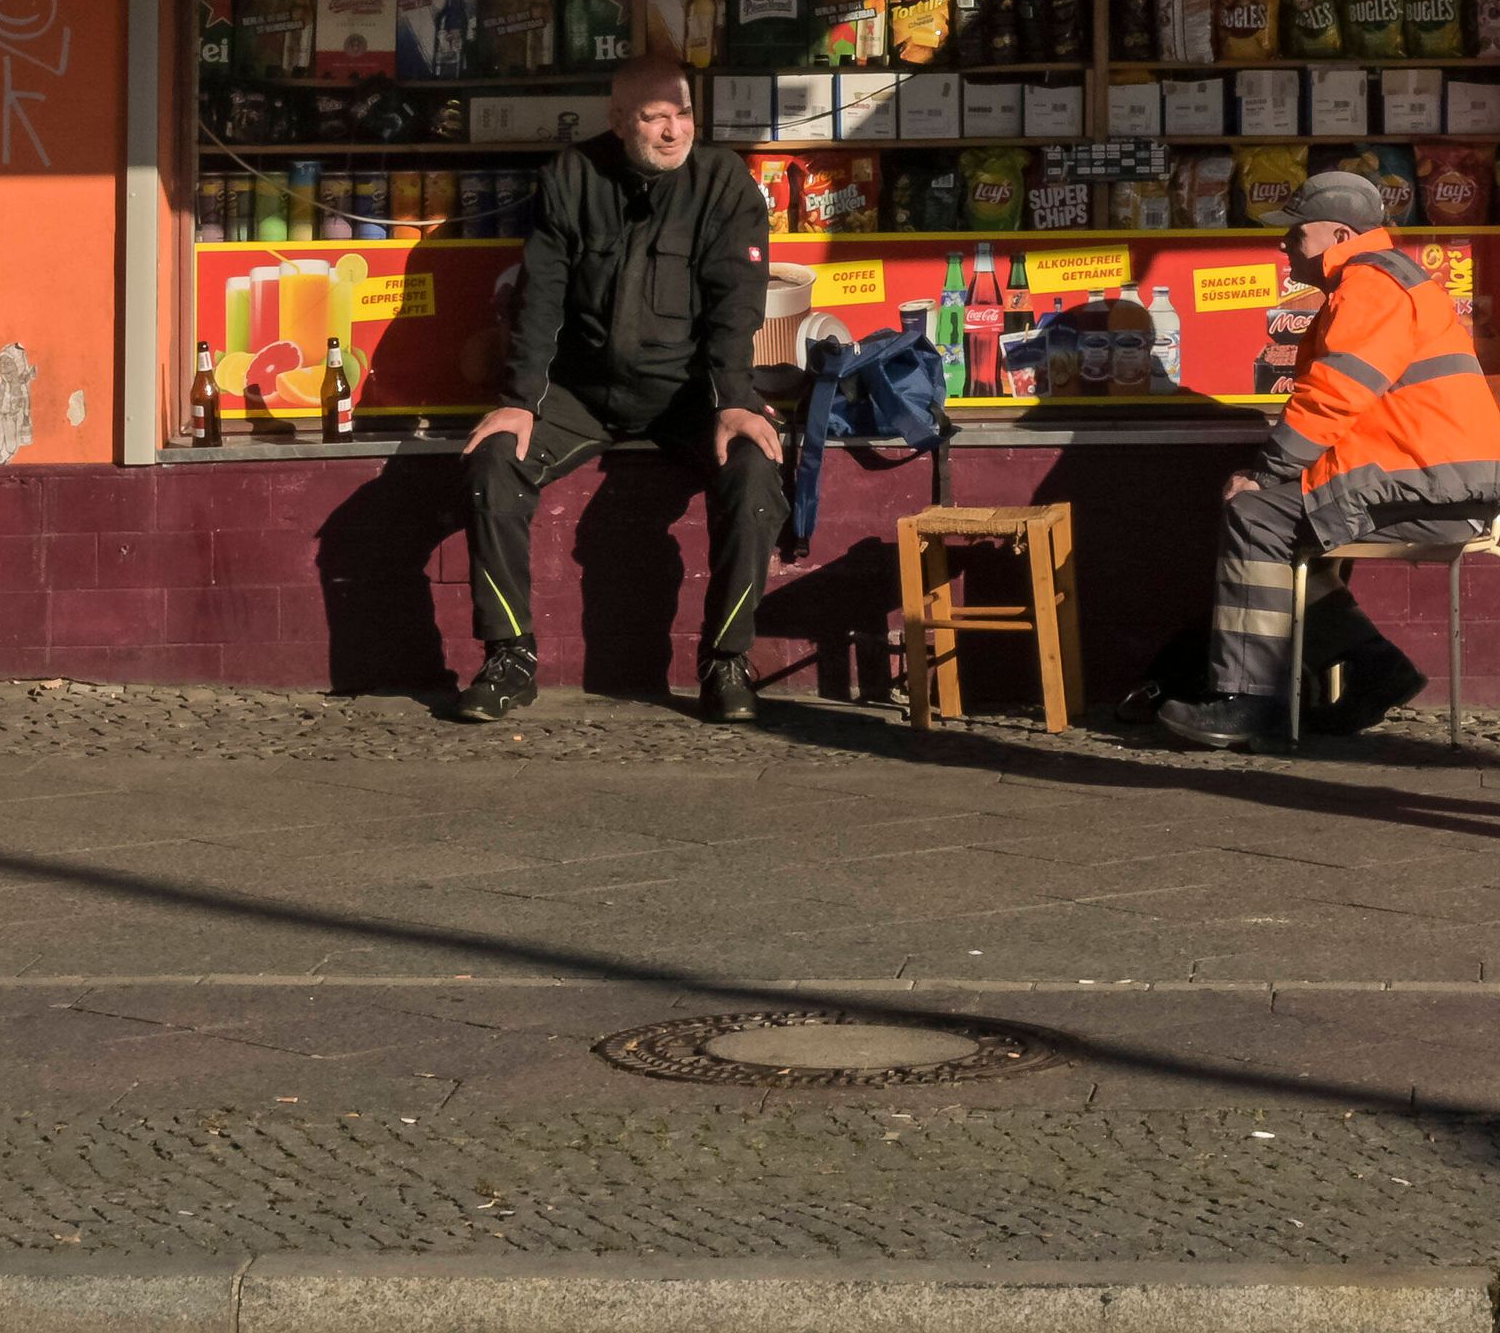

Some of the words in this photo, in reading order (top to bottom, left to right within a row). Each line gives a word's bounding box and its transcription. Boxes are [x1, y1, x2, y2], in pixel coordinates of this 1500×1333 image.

[1029, 184, 1088, 211] SUPER
[1435, 181, 1473, 202] Lay's
[1037, 254, 1123, 271] ALKOHOLFREIE
[833, 269, 876, 282] COFFEE
[1062, 266, 1123, 282] GETRÄNKE
[385, 277, 426, 290] FRISCH
[843, 284, 859, 294] TO
[860, 283, 876, 294] GO
[1201, 276, 1246, 289] SNACKS
[1249, 276, 1257, 285] &
[361, 290, 427, 306] GEPRESSTE
[1202, 286, 1271, 302] SÜSSWAREN
